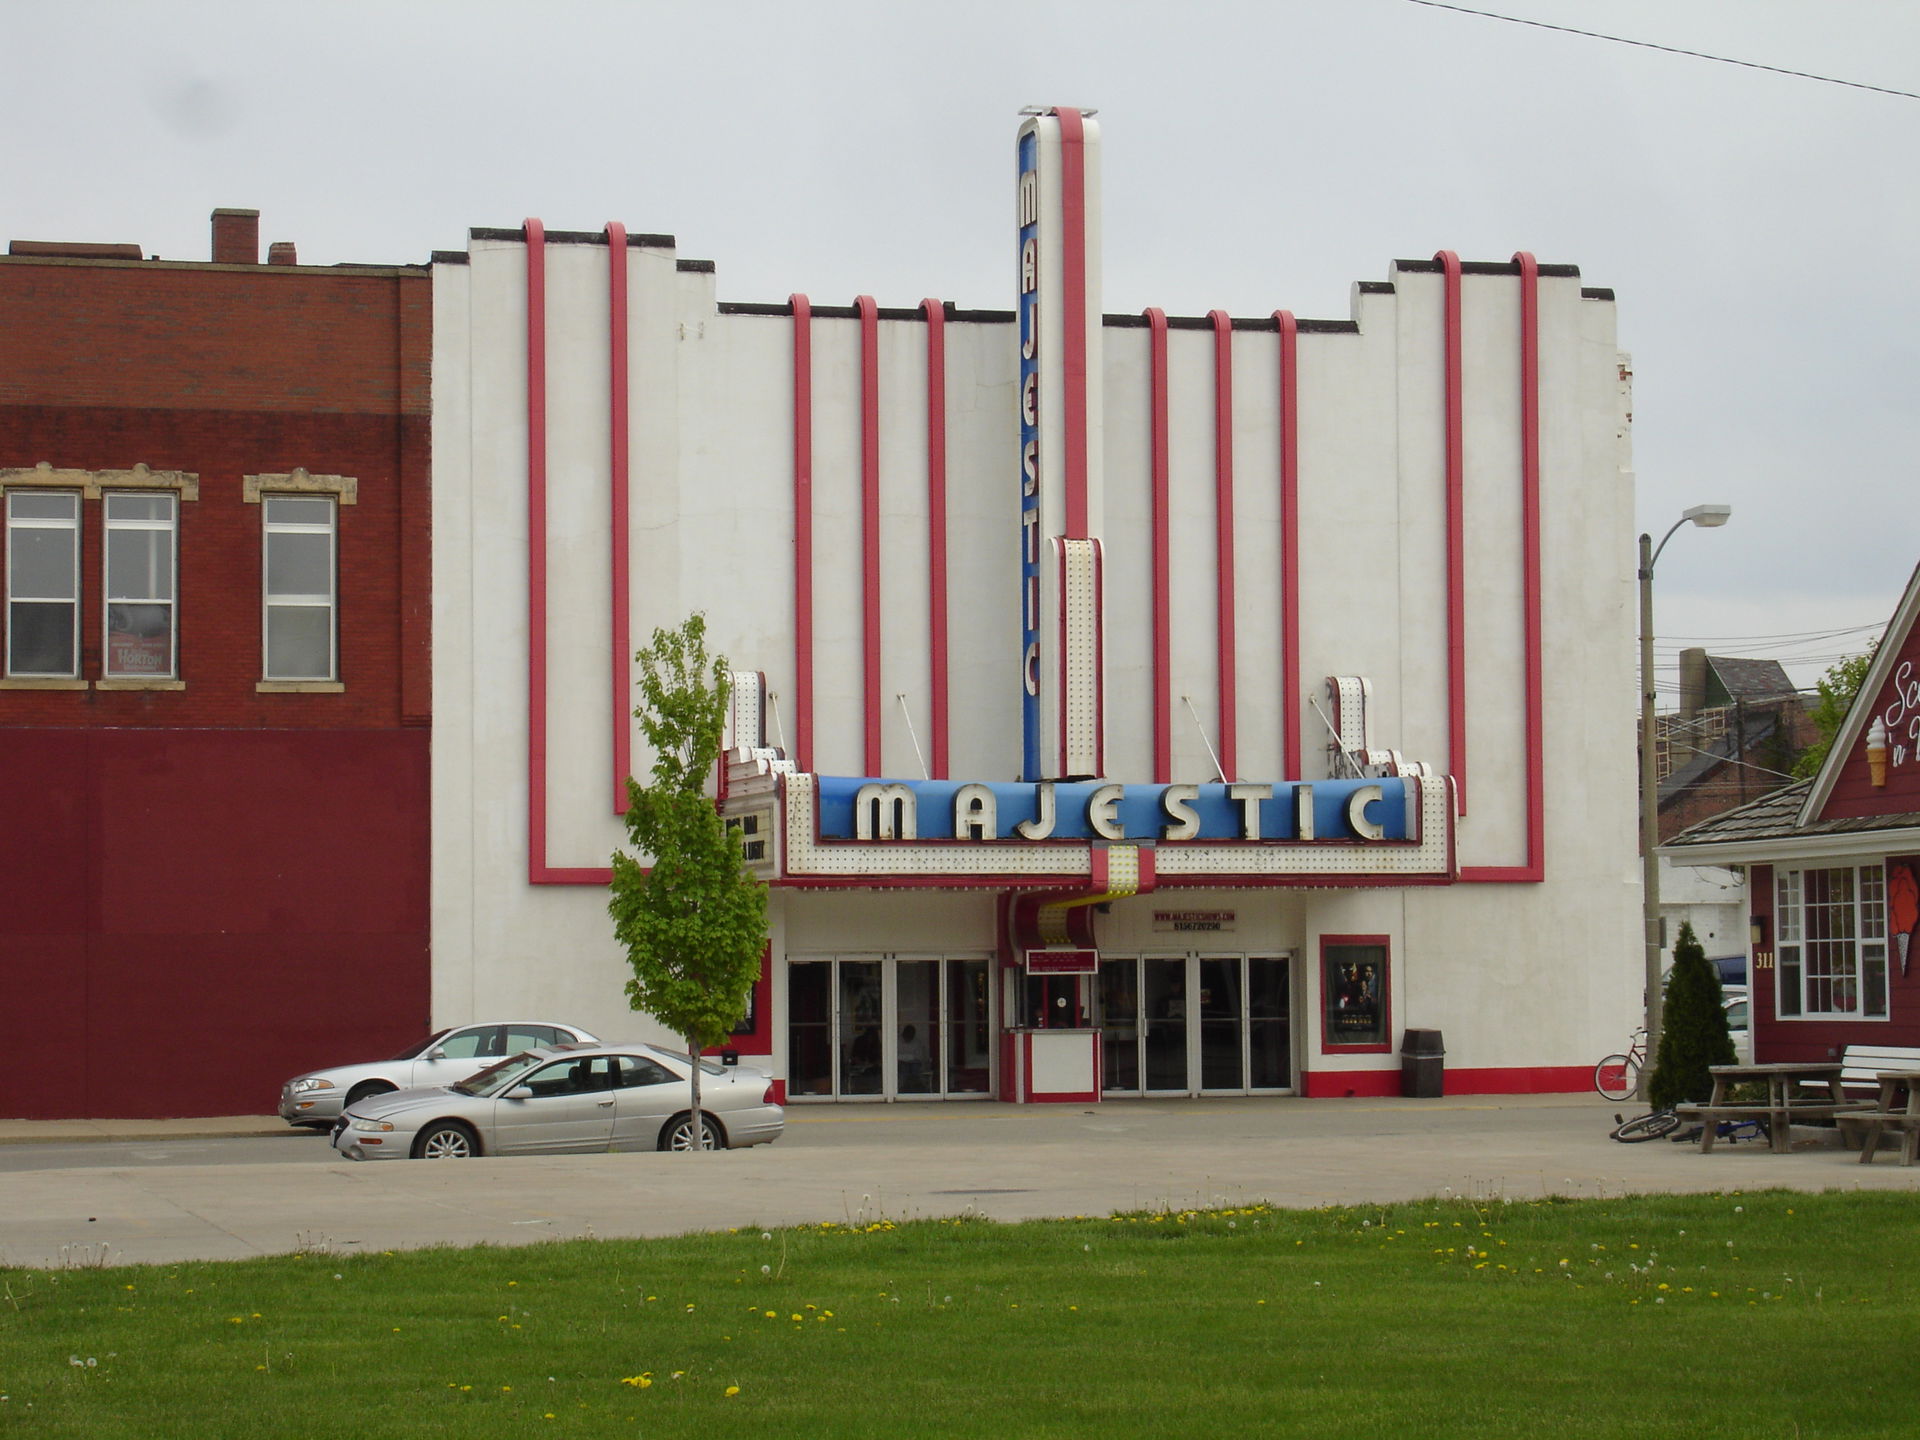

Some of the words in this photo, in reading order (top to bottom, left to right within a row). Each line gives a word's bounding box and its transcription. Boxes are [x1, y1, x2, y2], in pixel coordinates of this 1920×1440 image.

[1019, 170, 1040, 697] MAJESTIC
[854, 783, 1384, 841] MAJESTIC
[1755, 951, 1774, 969] 311
